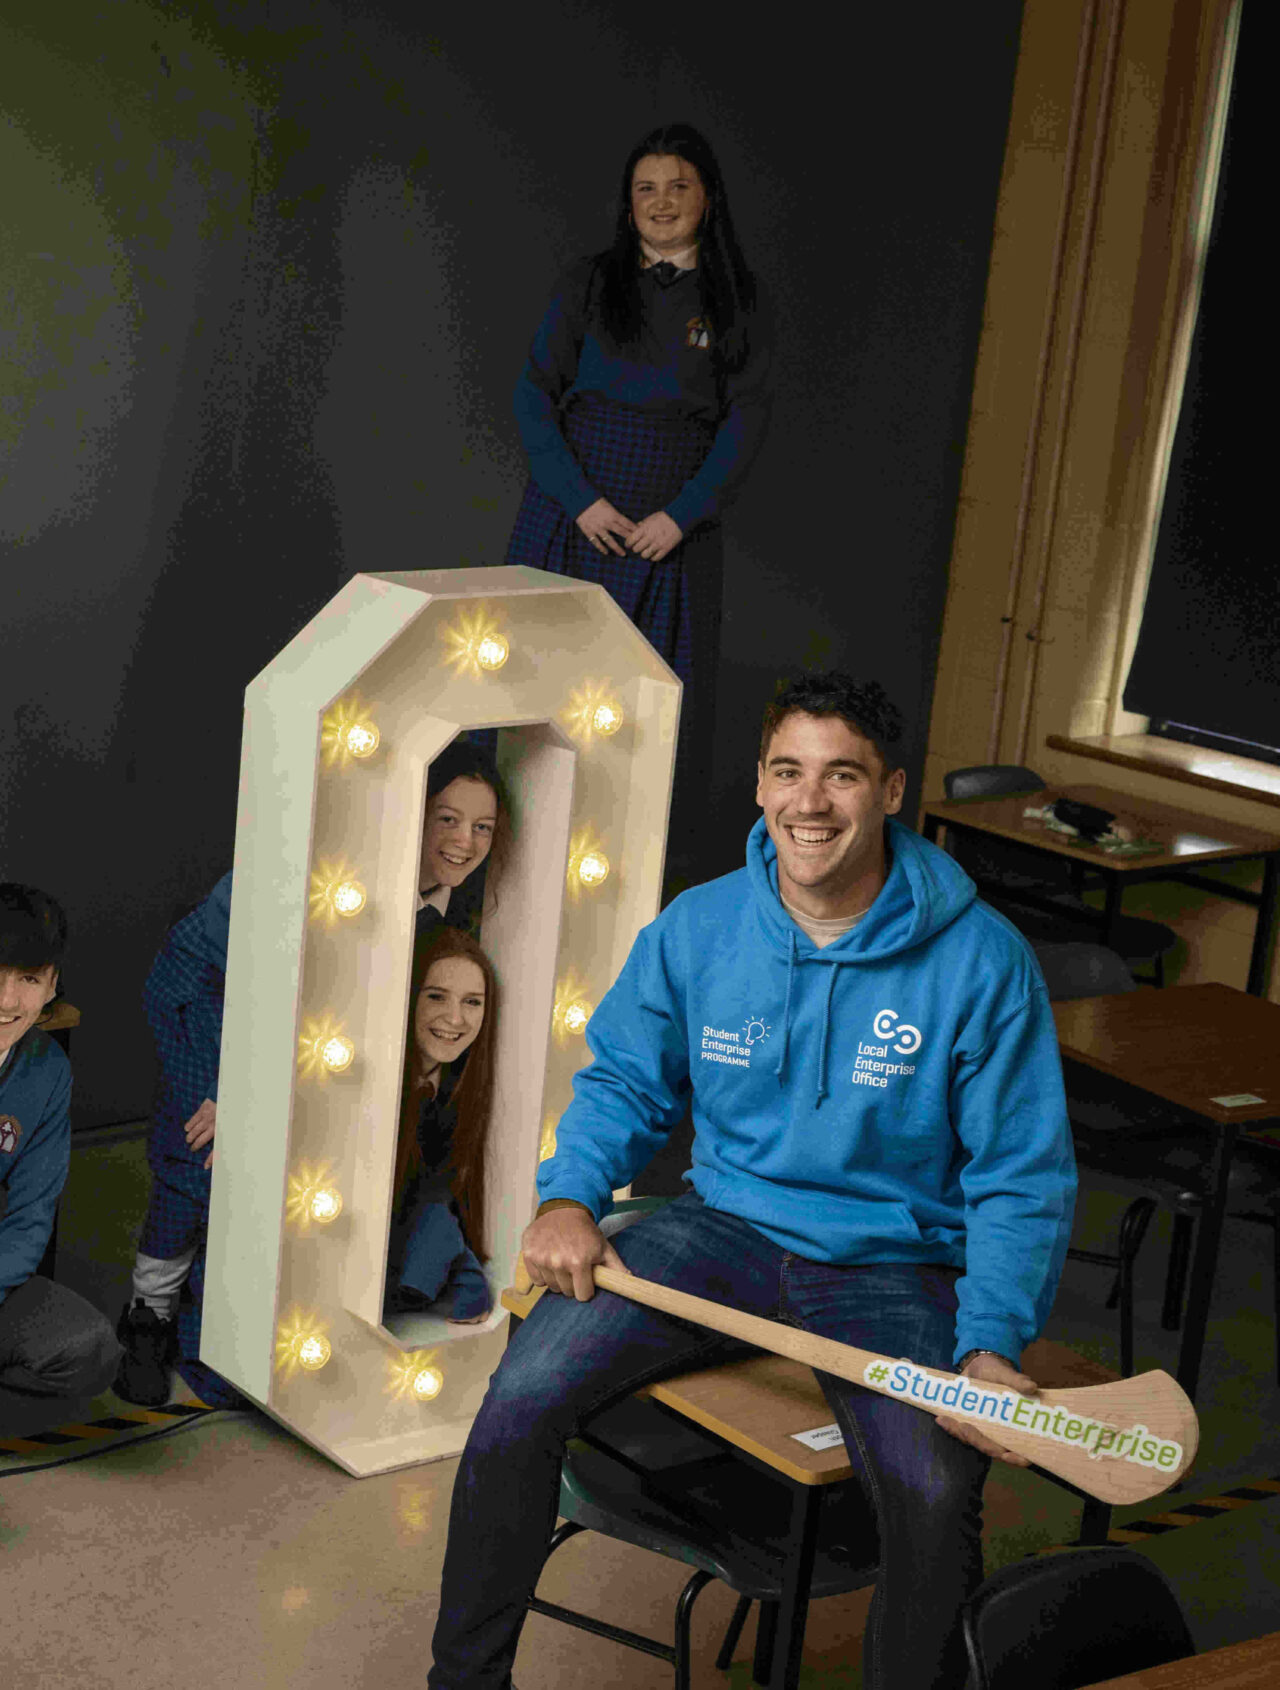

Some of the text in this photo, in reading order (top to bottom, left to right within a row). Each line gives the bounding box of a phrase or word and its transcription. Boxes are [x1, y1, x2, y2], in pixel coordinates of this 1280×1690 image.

[702, 1025, 740, 1042] Student
[701, 1038, 751, 1057] Enterprise
[857, 1042, 888, 1058] Local
[701, 1052, 750, 1068] PROGRAMME
[854, 1057, 916, 1076] Enterprise
[852, 1070, 888, 1088] Office
[867, 1364, 1178, 1468] #StudentEnterprise
